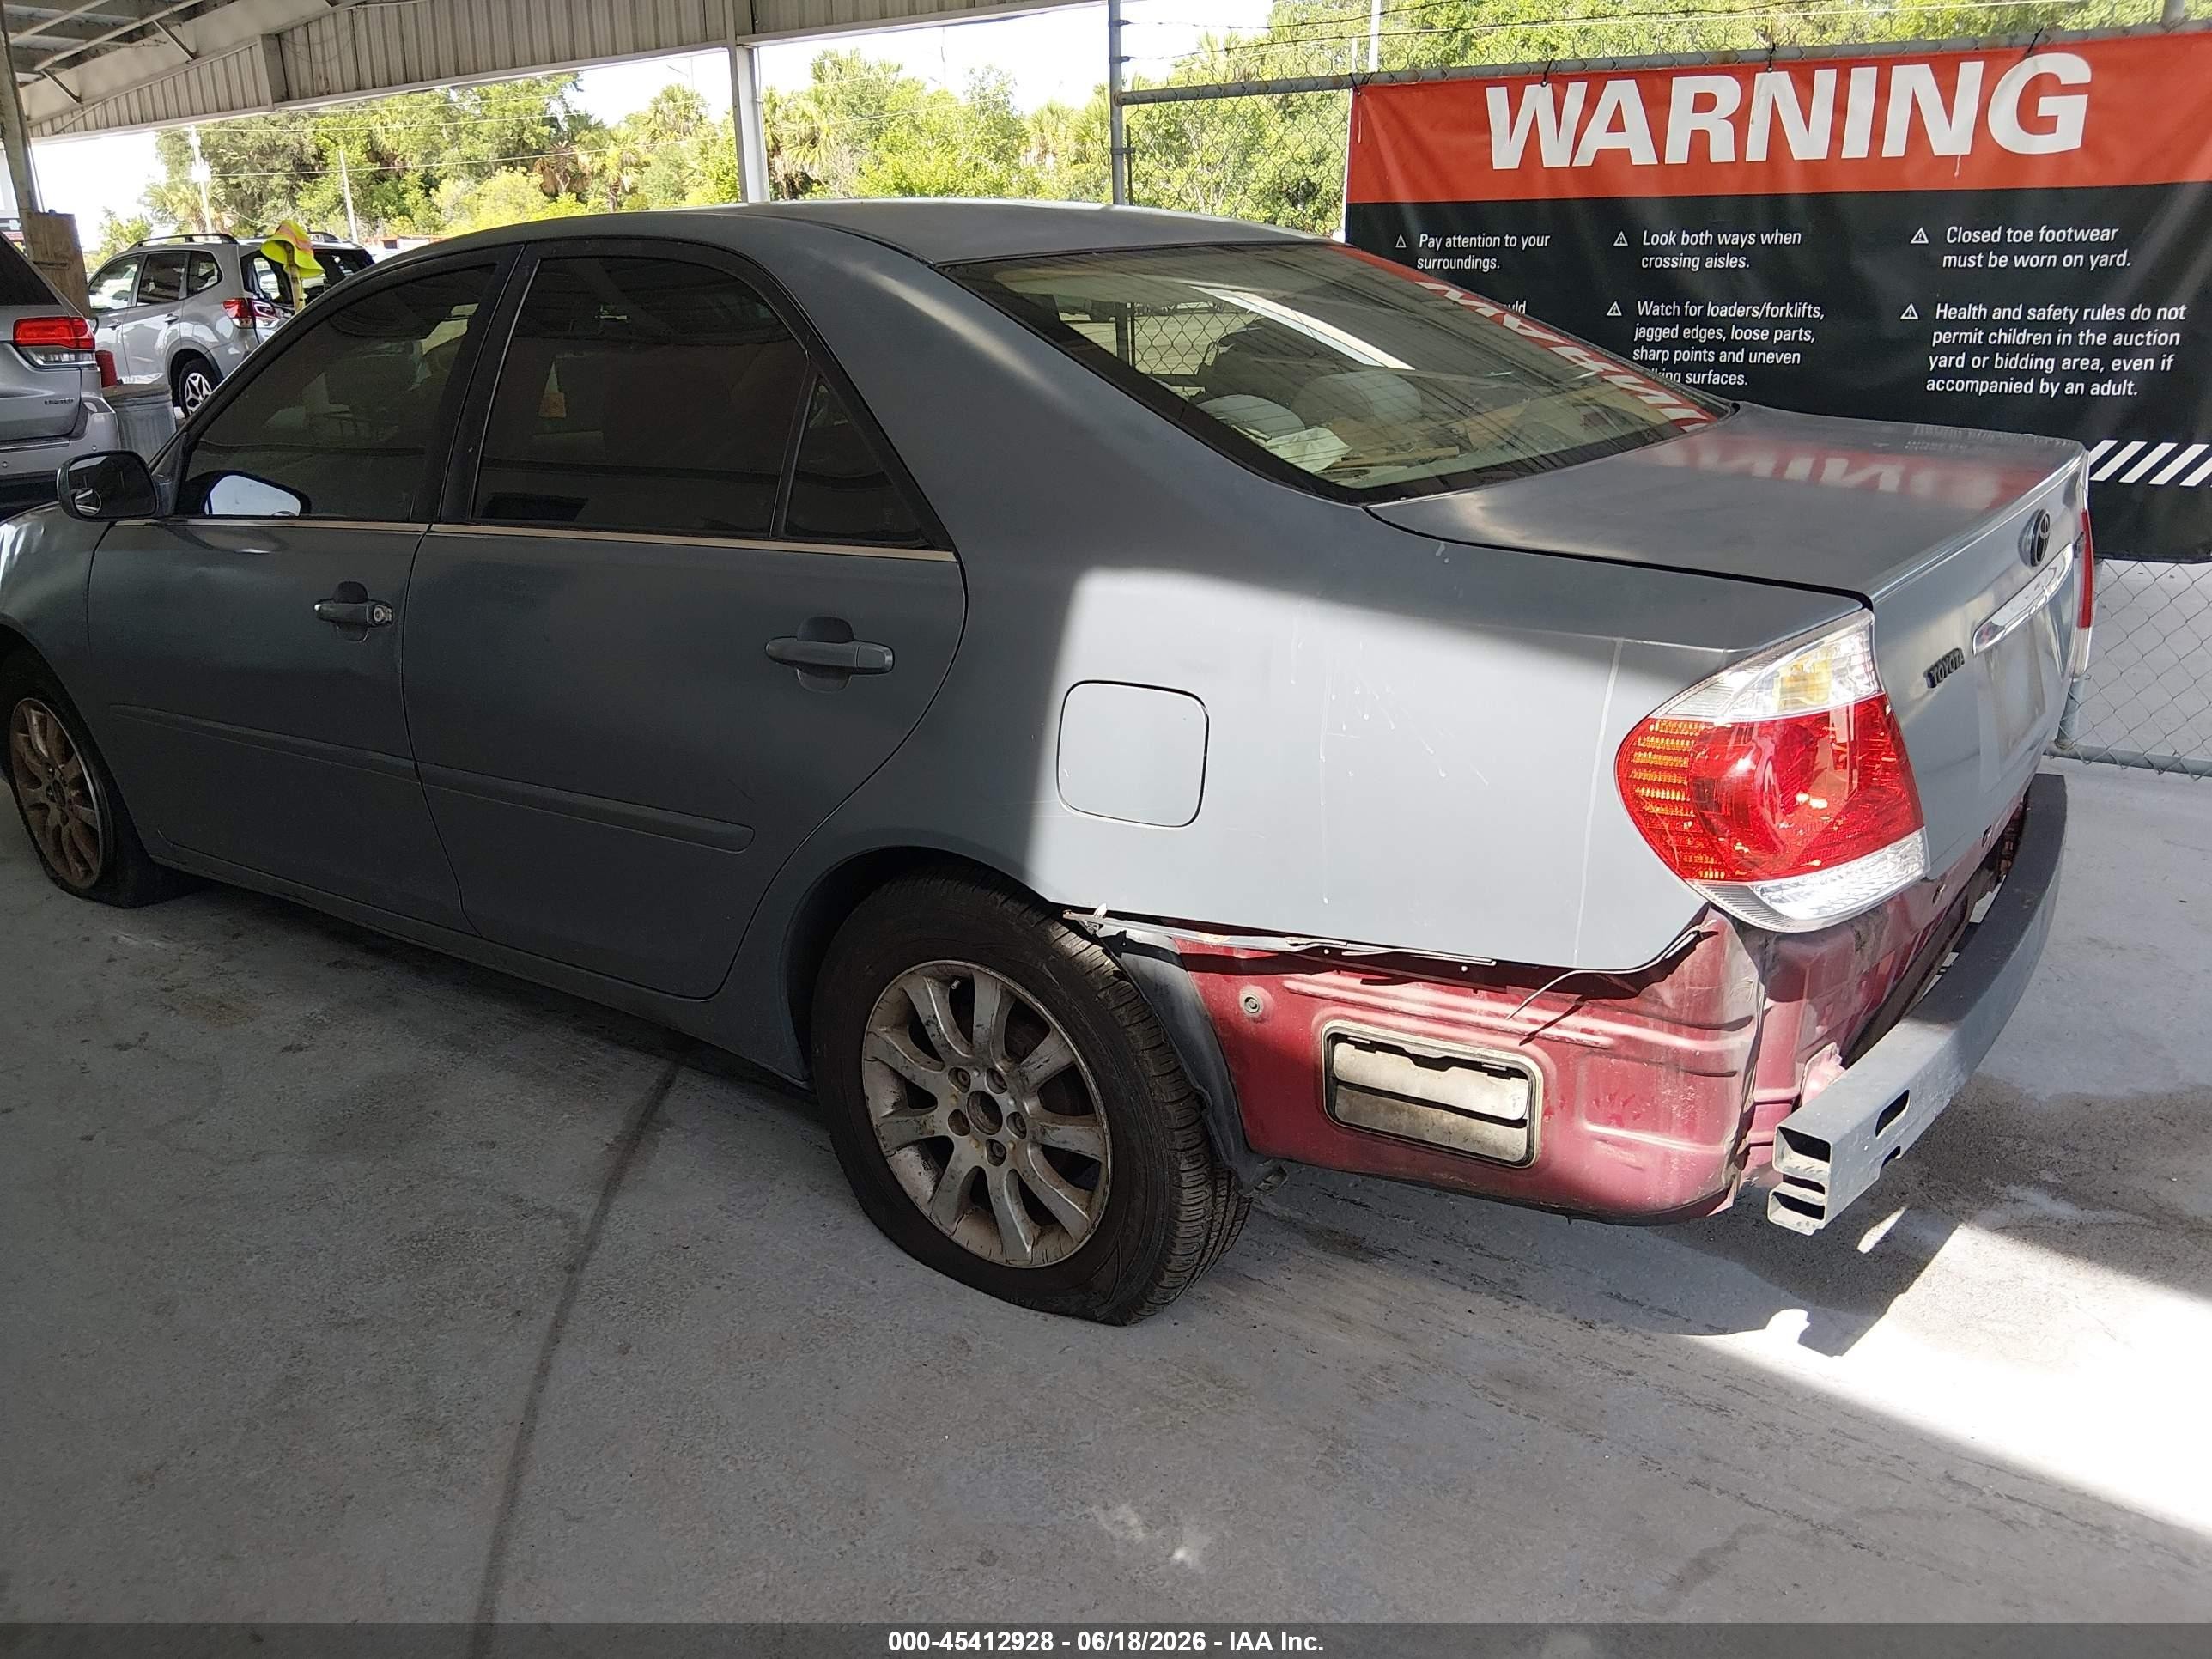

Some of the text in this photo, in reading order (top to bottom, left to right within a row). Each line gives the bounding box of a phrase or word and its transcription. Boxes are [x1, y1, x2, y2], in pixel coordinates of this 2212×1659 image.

[1486, 53, 2092, 170] WARNING
[1419, 234, 1550, 251] Pay attention to your
[1644, 229, 1801, 248] Look both ways when
[1947, 226, 2118, 243] Closed toe footwear
[1418, 255, 1499, 272] surroundings.
[1642, 253, 1749, 271] crossing aisles.
[1943, 249, 2130, 270] must be worn on yard.
[1638, 301, 1824, 319] Watch for loaders/forklifts,
[1936, 303, 2186, 324] Health and safety rules do not
[1633, 323, 1815, 344] jagged edges, loose parts,
[1933, 328, 2179, 346] permit children in the auction
[1632, 346, 1800, 364] sharp points and uneven
[1929, 352, 2174, 373] yard or bidding area, even if
[1686, 370, 1747, 385] surfaces.
[1927, 378, 2137, 398] accompanied by an adult.
[1923, 647, 1965, 688] TOYOTA
